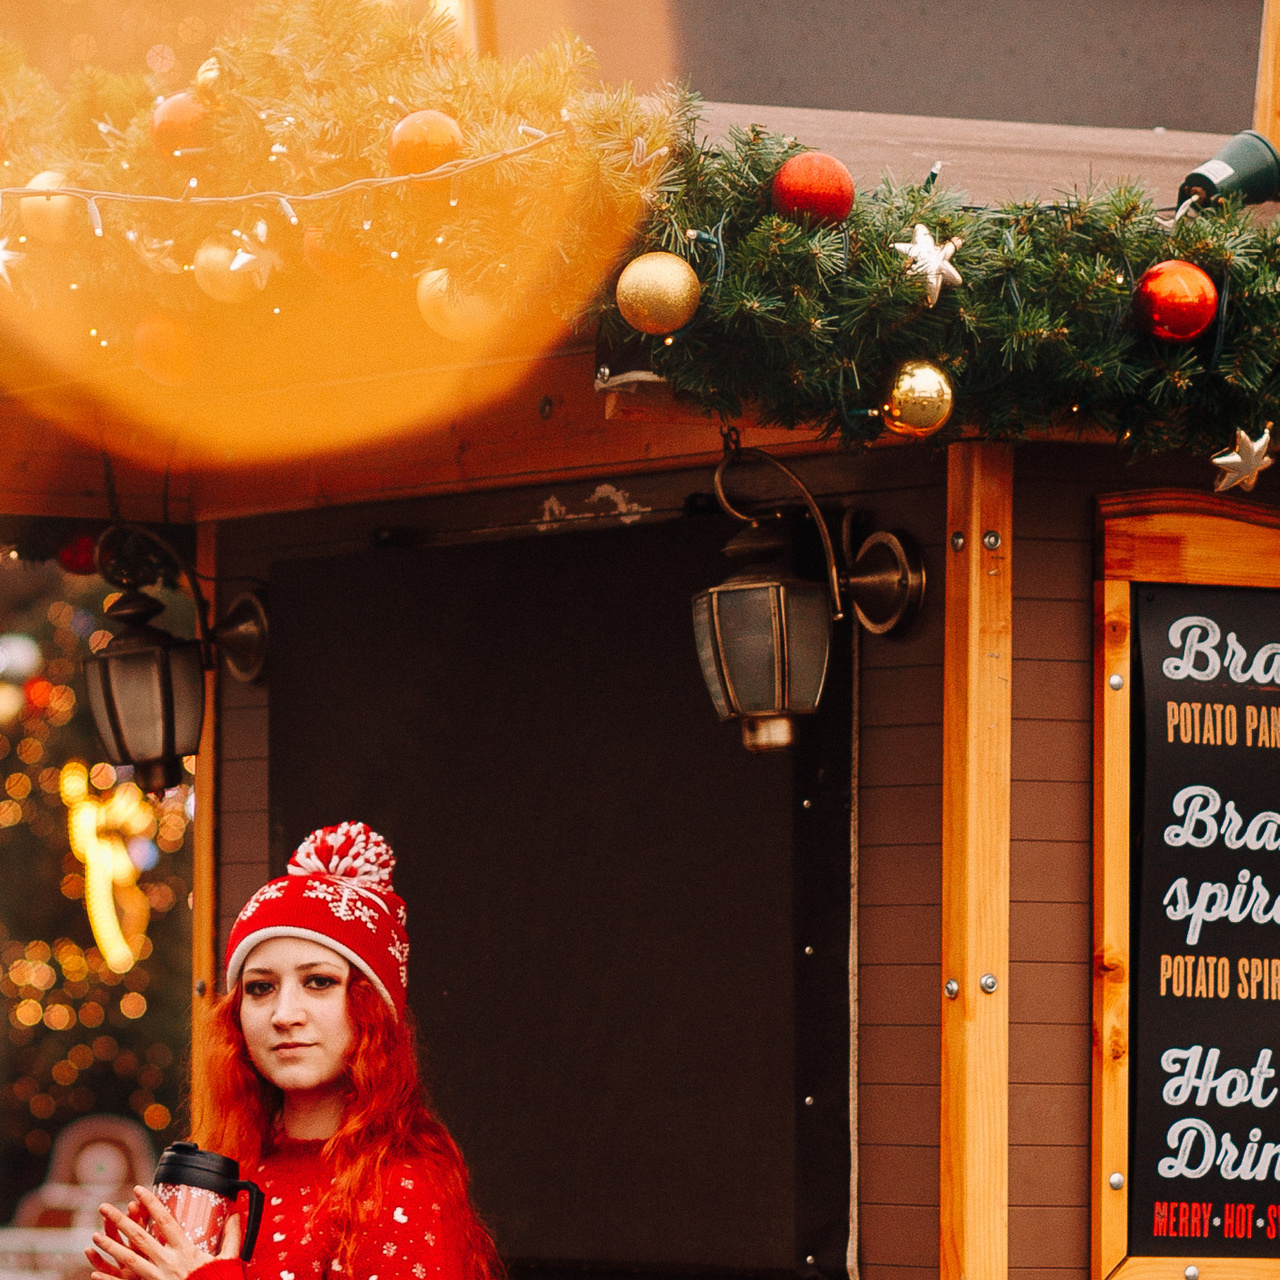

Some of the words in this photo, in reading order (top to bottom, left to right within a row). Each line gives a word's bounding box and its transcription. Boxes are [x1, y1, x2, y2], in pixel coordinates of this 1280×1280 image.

[1166, 701, 1238, 746] POTATO
[1162, 869, 1280, 946] spir
[1160, 954, 1230, 999] POTATO
[1161, 1045, 1279, 1108] Hot
[1157, 1118, 1280, 1181] Drin
[1153, 1201, 1213, 1239] MERRY
[1223, 1202, 1255, 1239] HOT
